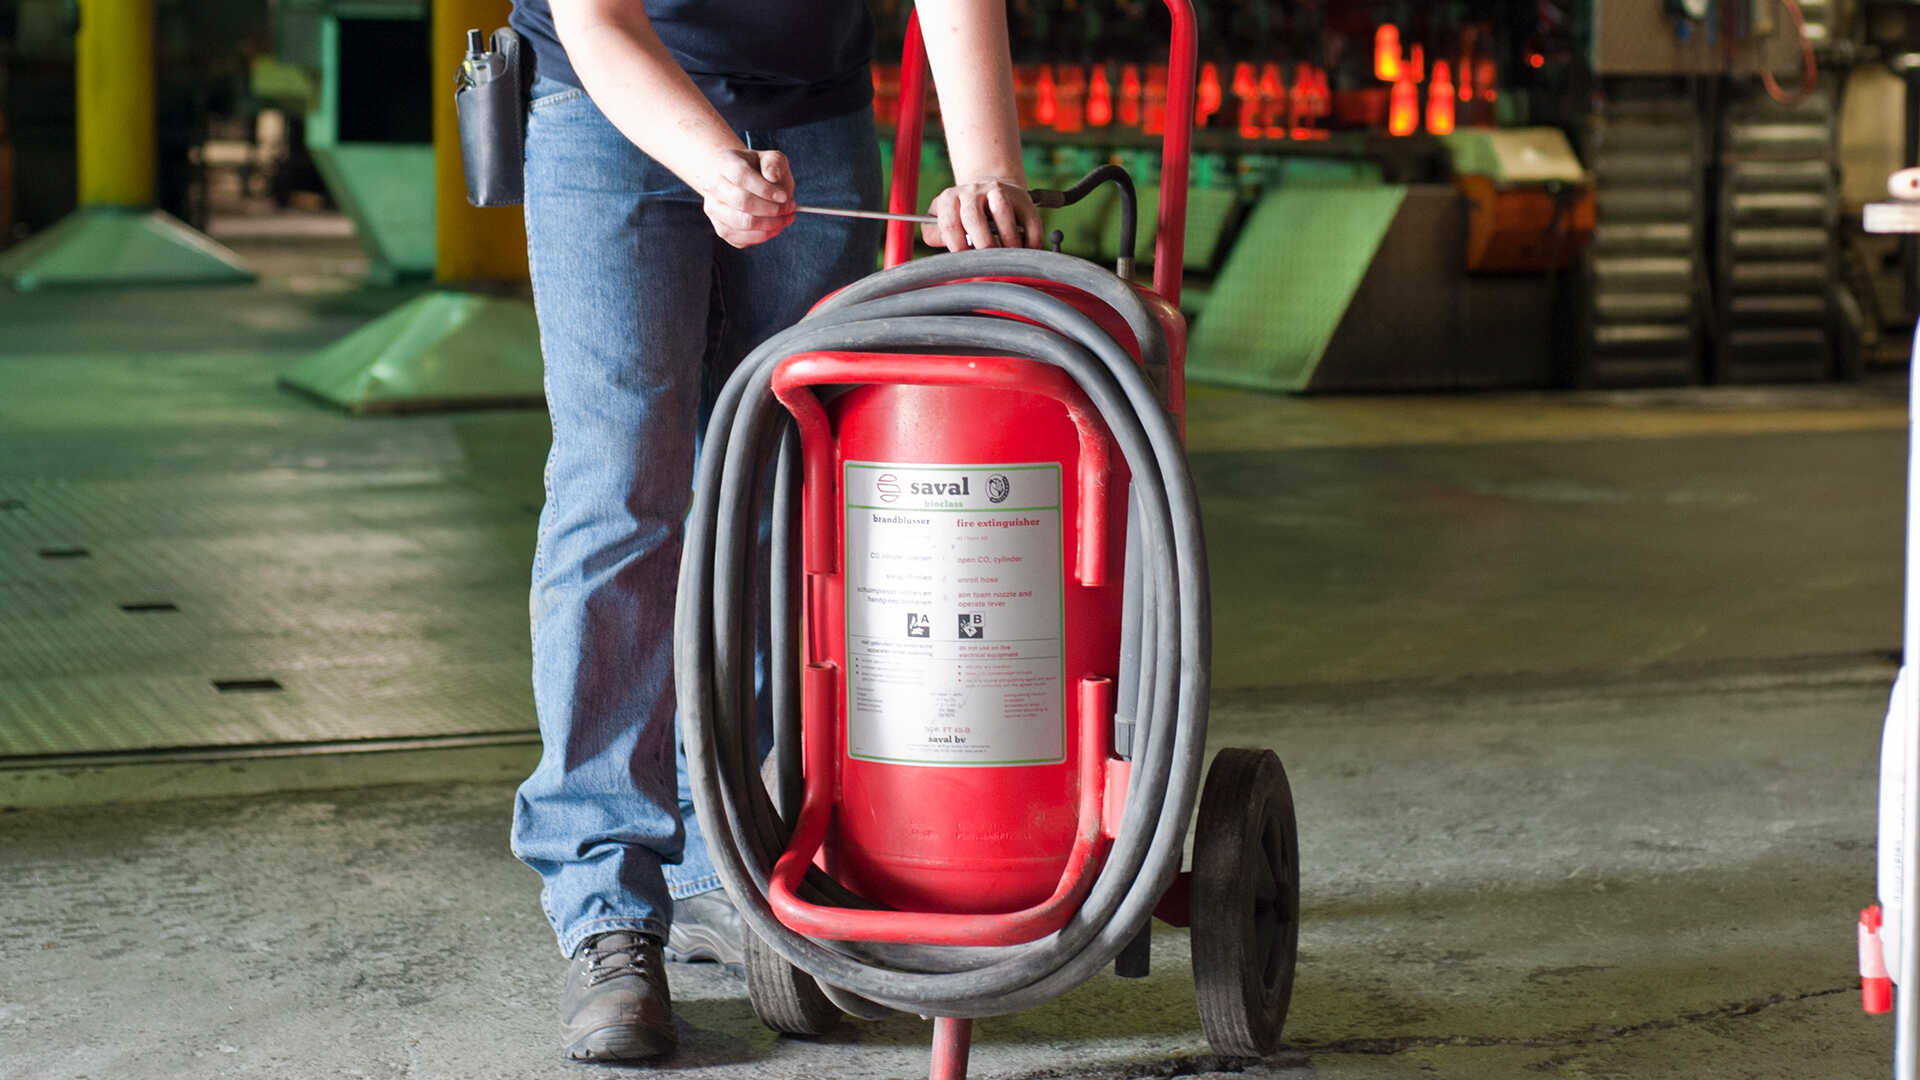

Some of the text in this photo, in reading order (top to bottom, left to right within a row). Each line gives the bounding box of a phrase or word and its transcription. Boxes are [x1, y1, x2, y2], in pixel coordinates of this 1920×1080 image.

[910, 477, 970, 495] saval
[957, 518, 1040, 528] fire extinguisher
[993, 556, 1023, 564] cylinder
[921, 614, 929, 624] A
[974, 614, 982, 624] B
